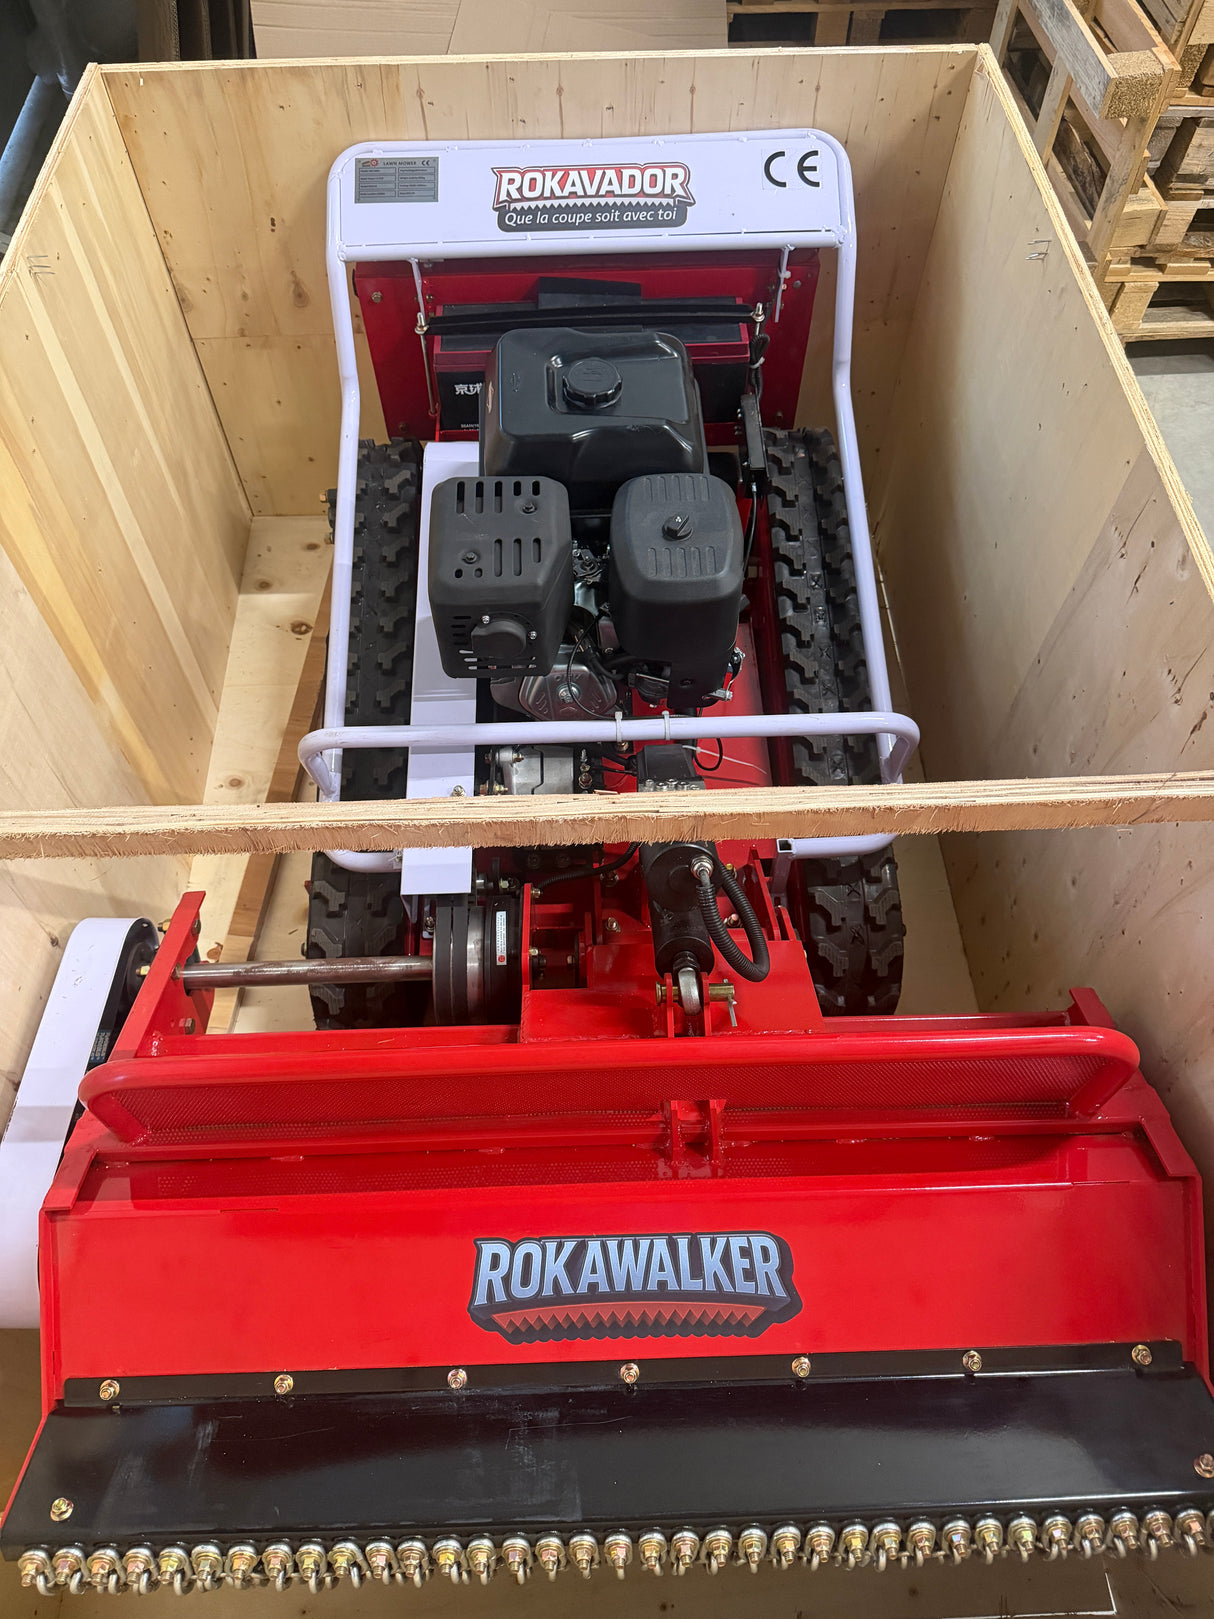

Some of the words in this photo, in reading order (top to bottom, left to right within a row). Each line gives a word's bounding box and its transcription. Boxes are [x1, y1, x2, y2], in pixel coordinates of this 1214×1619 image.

[499, 167, 687, 202] ROKAVADOR
[764, 150, 820, 188] CE
[505, 212, 532, 226] Que
[536, 211, 550, 224] la
[552, 212, 592, 226] coupe
[595, 209, 620, 222] soit
[623, 210, 654, 222] avec
[657, 208, 677, 221] toi
[474, 1234, 789, 1306] ROKAWALKER
